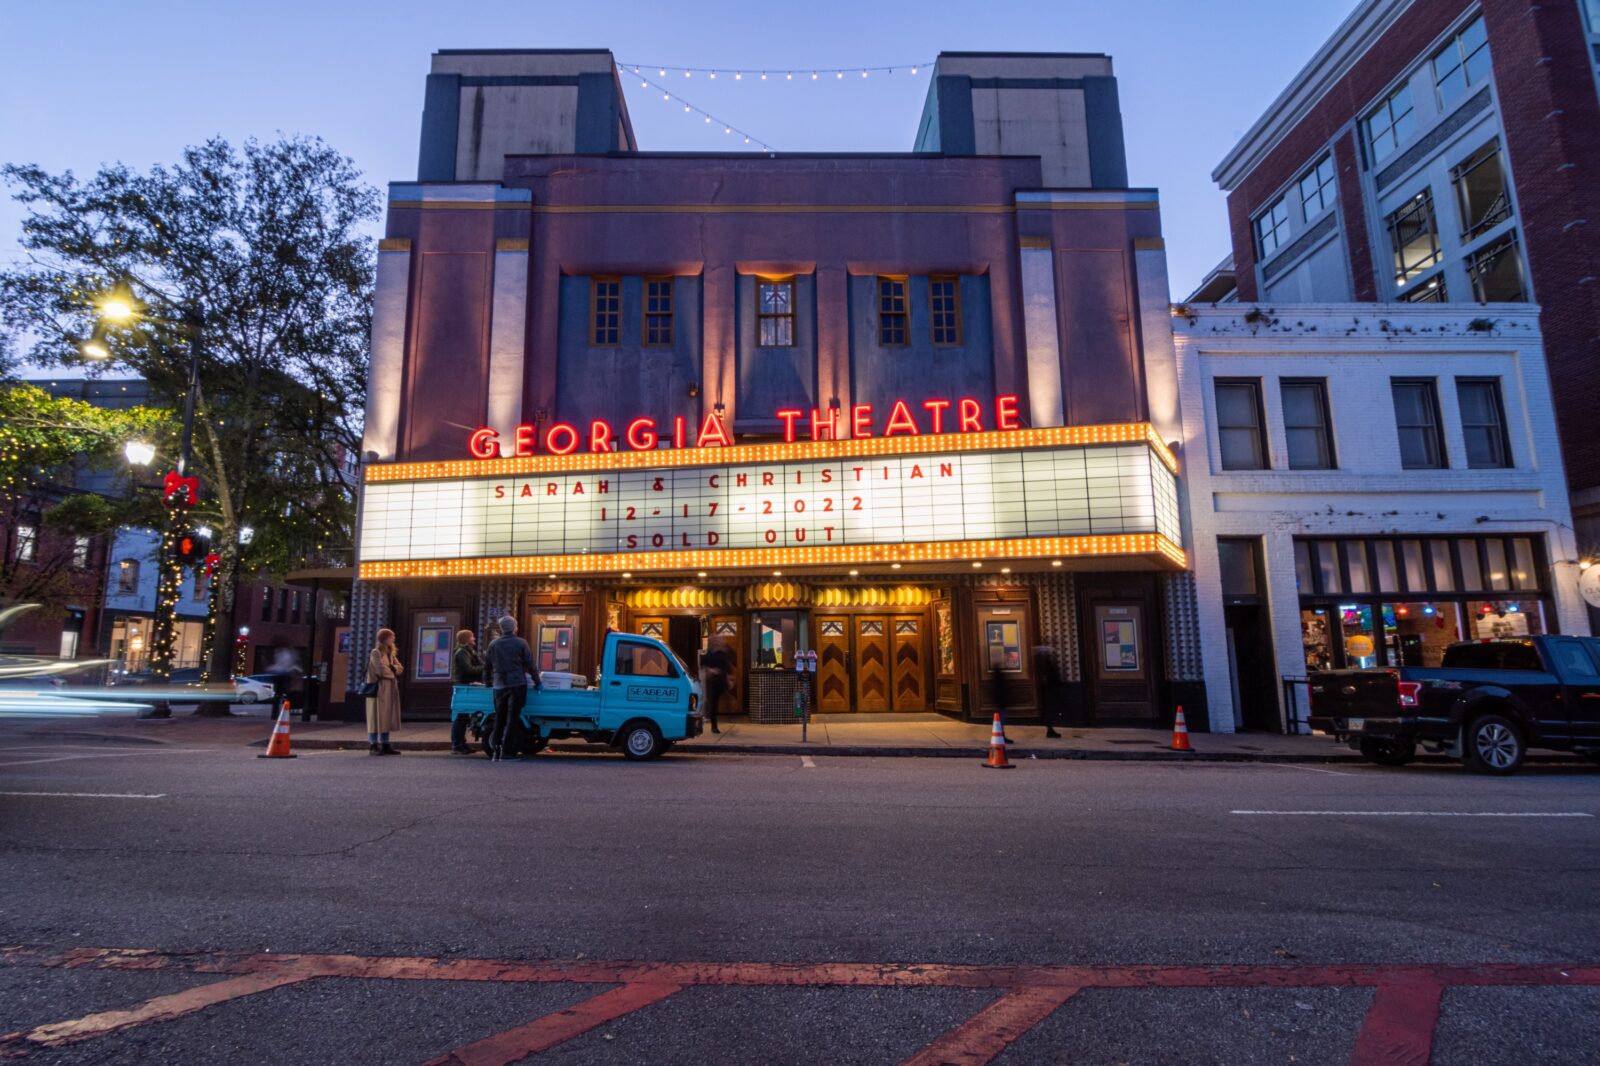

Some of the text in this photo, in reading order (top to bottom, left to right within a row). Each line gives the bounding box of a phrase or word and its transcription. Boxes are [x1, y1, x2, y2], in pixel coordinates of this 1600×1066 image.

[470, 395, 1021, 459] GEORGIA THEATRE
[494, 463, 954, 499] SARAH & CHRISTIAN
[600, 496, 865, 522] 12-17-2022
[626, 527, 835, 549] SOLD OUT
[629, 687, 677, 698] SEABEAR
